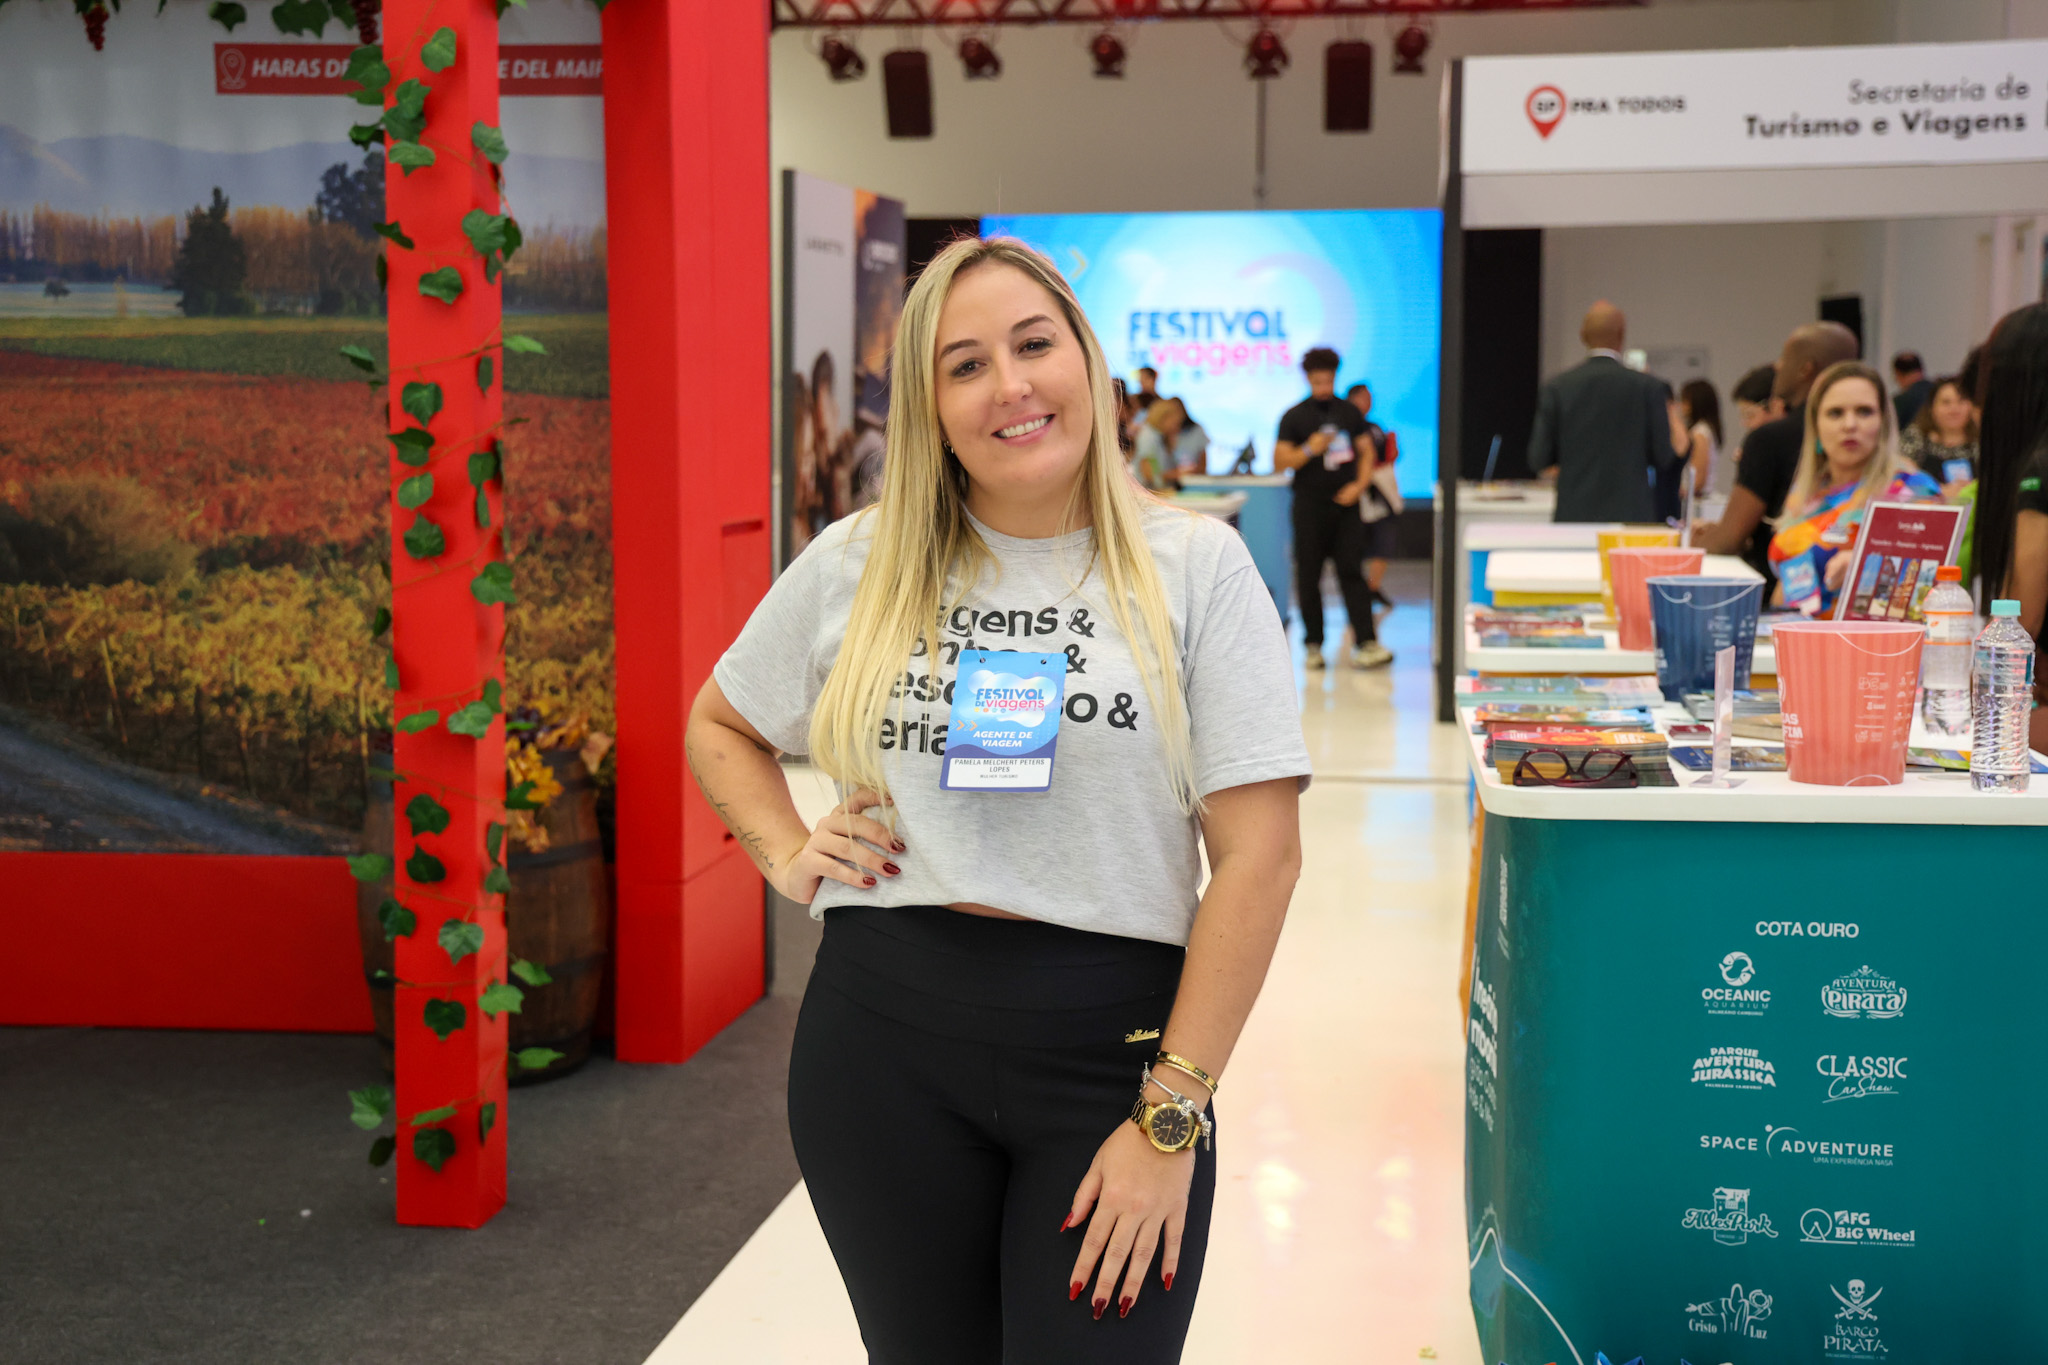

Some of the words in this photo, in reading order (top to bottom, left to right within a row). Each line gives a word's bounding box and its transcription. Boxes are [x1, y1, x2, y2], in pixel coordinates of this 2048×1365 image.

[252, 58, 320, 78] HARAS
[512, 59, 551, 79] DEL
[1849, 77, 1986, 105] Secretaria
[1995, 73, 2031, 101] de
[1571, 98, 1610, 113] PRA
[1616, 97, 1687, 113] TODOS
[1745, 113, 1860, 137] Turismo
[1872, 118, 1889, 135] e
[1901, 110, 2027, 140] Viagens
[1066, 608, 1095, 638] &
[976, 688, 1044, 700] FESTIVAL
[974, 700, 986, 708] DE
[986, 699, 1046, 711] viagens
[1107, 692, 1139, 731] &
[973, 731, 1015, 739] AGENTE
[1018, 731, 1033, 739] DE
[982, 740, 1022, 748] VIAGEM
[1755, 921, 1803, 937] COTA
[1807, 922, 1860, 939] OURO
[1832, 978, 1896, 990] AVENTURA
[1701, 988, 1771, 1003] OCEANIC
[1703, 1000, 1769, 1009] AQUARIUM
[1710, 1047, 1759, 1058] PARQUE
[1692, 1055, 1776, 1074] AVENTURA
[1816, 1055, 1908, 1079] CLASSIC
[1691, 1065, 1777, 1088] JURÁSSICA
[1828, 1076, 1857, 1099] Car
[1700, 1135, 1758, 1151] SPACE
[1781, 1140, 1894, 1158] ADVENTURE
[1813, 1156, 1830, 1164] UMA
[1830, 1157, 1874, 1166] EXPERIÊNCIA
[1874, 1159, 1894, 1167] NASA
[1866, 1228, 1916, 1242] Wheel
[1688, 1318, 1718, 1334] Cristo
[1750, 1325, 1768, 1340] Luz
[1835, 1321, 1879, 1338] BARCO
[1823, 1335, 1889, 1354] PIRATA
